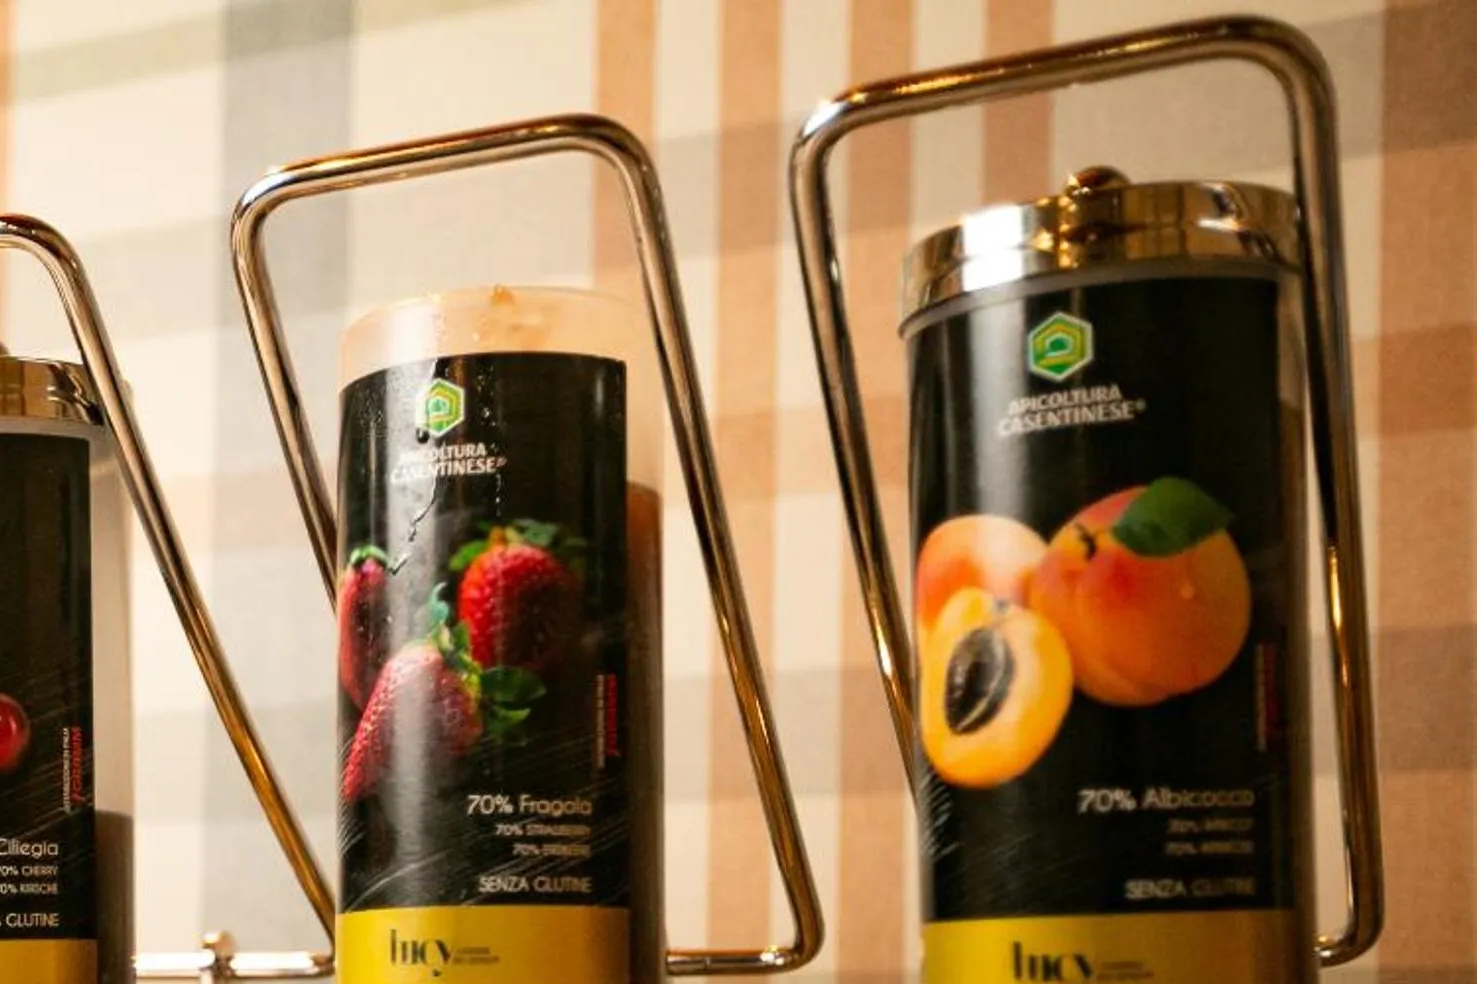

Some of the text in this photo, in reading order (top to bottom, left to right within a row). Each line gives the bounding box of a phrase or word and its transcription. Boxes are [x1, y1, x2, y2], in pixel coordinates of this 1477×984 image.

[1007, 384, 1123, 414] APICOLTURA
[466, 793, 593, 816] 70% Fragola
[1077, 789, 1137, 815] 70%
[478, 876, 593, 893] SENZA GLUTINE
[5, 912, 59, 928] GLUTINE
